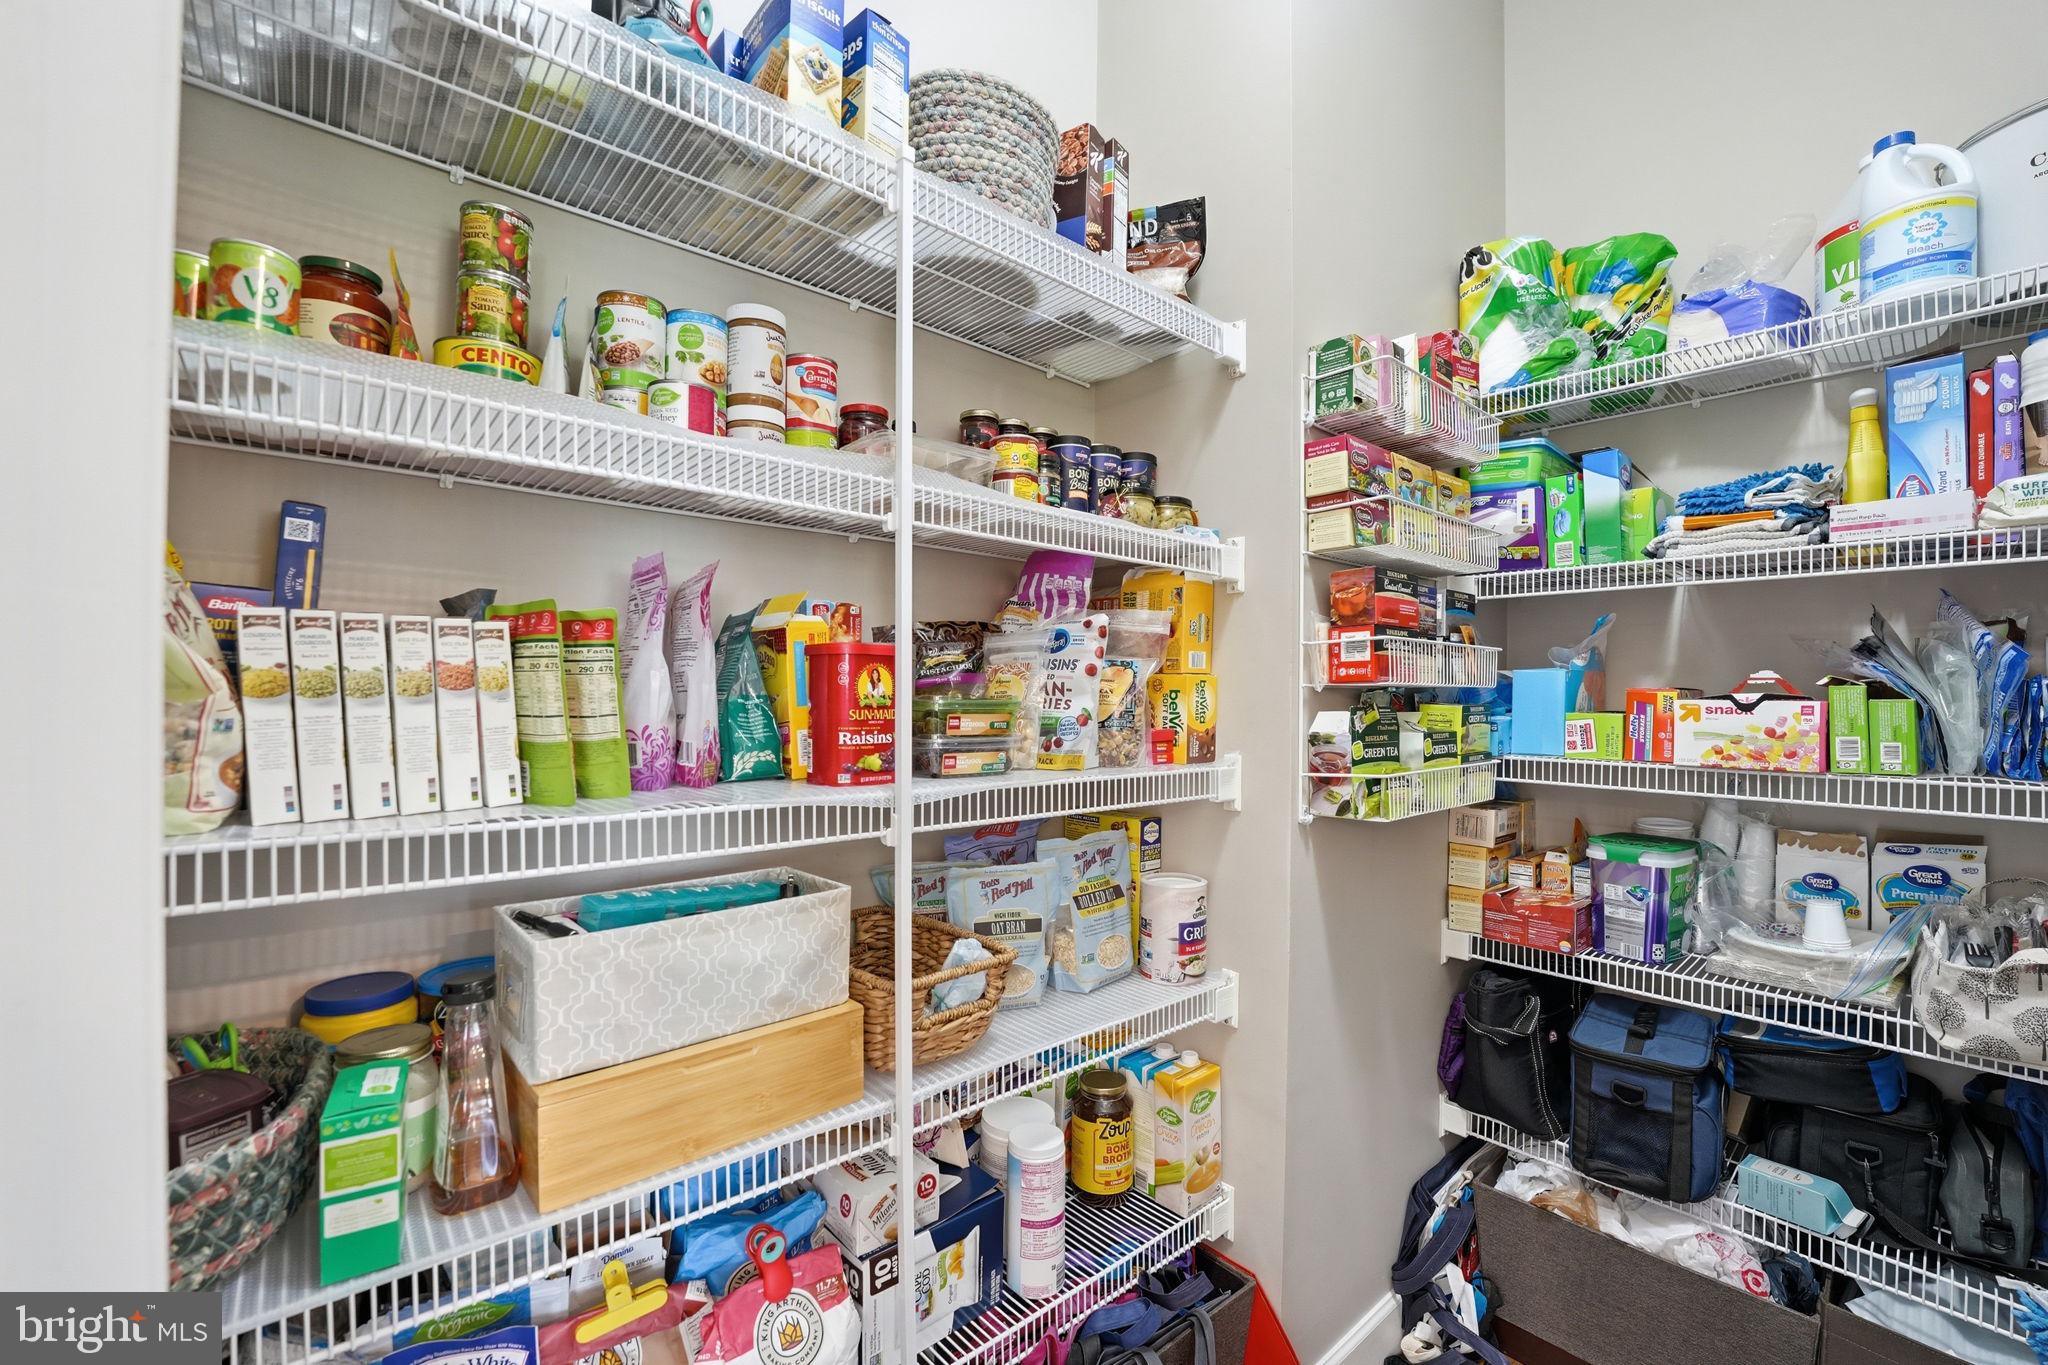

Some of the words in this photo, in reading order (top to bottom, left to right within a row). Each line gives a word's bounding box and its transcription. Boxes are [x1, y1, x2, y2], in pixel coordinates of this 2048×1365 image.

[1907, 242, 1944, 256] Bleach
[1470, 275, 1492, 294] Upper
[617, 316, 646, 327] LENTILS
[461, 346, 533, 377] CENTO
[1938, 470, 1947, 495] Wand
[1498, 497, 1517, 506] WET
[578, 665, 594, 674] 290
[597, 665, 614, 673] 470
[1630, 714, 1638, 739] Hefty
[838, 731, 893, 745] Raisins
[1363, 746, 1386, 759] GREEN
[1386, 744, 1399, 757] TEA
[1805, 876, 1833, 887] Great
[1907, 868, 1943, 883] Great
[1916, 877, 1943, 885] Value
[917, 880, 937, 898] Red
[991, 884, 1011, 905] Red
[1010, 877, 1035, 899] Mill
[1812, 881, 1833, 890] Value
[1847, 907, 1860, 916] 48
[990, 922, 1005, 936] OAT
[1005, 920, 1026, 935] BRAN
[1105, 1142, 1131, 1155] BONE
[919, 1178, 934, 1191] 10
[840, 1196, 851, 1213] 10
[872, 1199, 897, 1230] Milano
[601, 1246, 634, 1265] Domino
[636, 1255, 655, 1266] SUGAR
[874, 1258, 892, 1290] 10
[922, 1268, 930, 1293] COD
[427, 1311, 497, 1341] Organic
[761, 1309, 775, 1342] KING
[775, 1297, 814, 1320] ARTHUR
